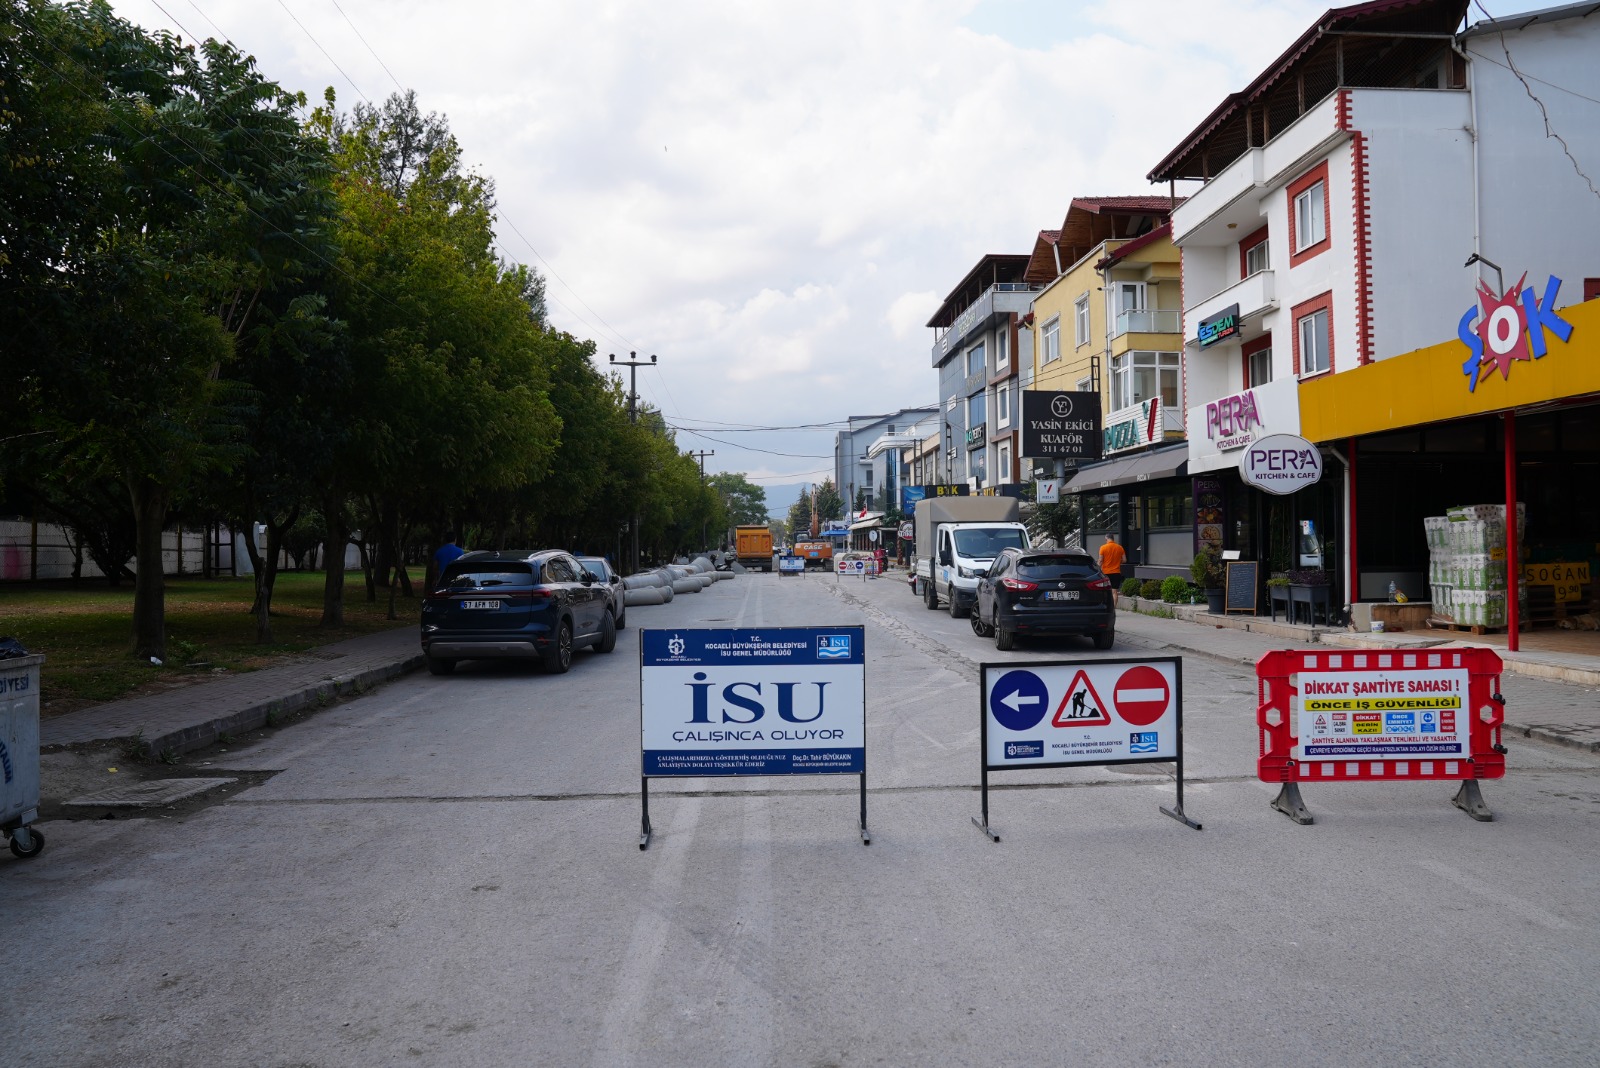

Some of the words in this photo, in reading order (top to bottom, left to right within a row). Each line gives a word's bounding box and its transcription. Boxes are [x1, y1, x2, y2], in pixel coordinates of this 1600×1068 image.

[1200, 314, 1234, 340] ESDEM
[1458, 274, 1574, 392] ŞOK
[1206, 390, 1260, 438] PERA
[1030, 418, 1062, 430] YASİN
[1065, 419, 1094, 430] EKİCİ
[1040, 433, 1083, 444] KUAFÖR
[1240, 434, 1250, 445] CAFE
[1251, 449, 1318, 470] PERA
[1526, 565, 1587, 581] SOĞAN
[831, 637, 848, 647] İSU
[1305, 680, 1349, 694] DİKKAT
[1352, 679, 1404, 696] ŞANTİYE
[1408, 680, 1452, 692] SAHASI
[1456, 679, 1459, 691] !
[684, 672, 832, 724] İSU
[1311, 699, 1351, 709] ÖNCE
[1356, 699, 1369, 710] İŞ
[1375, 698, 1455, 708] GÜVENLİĞİ
[672, 731, 764, 742] ÇALIŞINCA
[771, 730, 844, 740] OLUYOR
